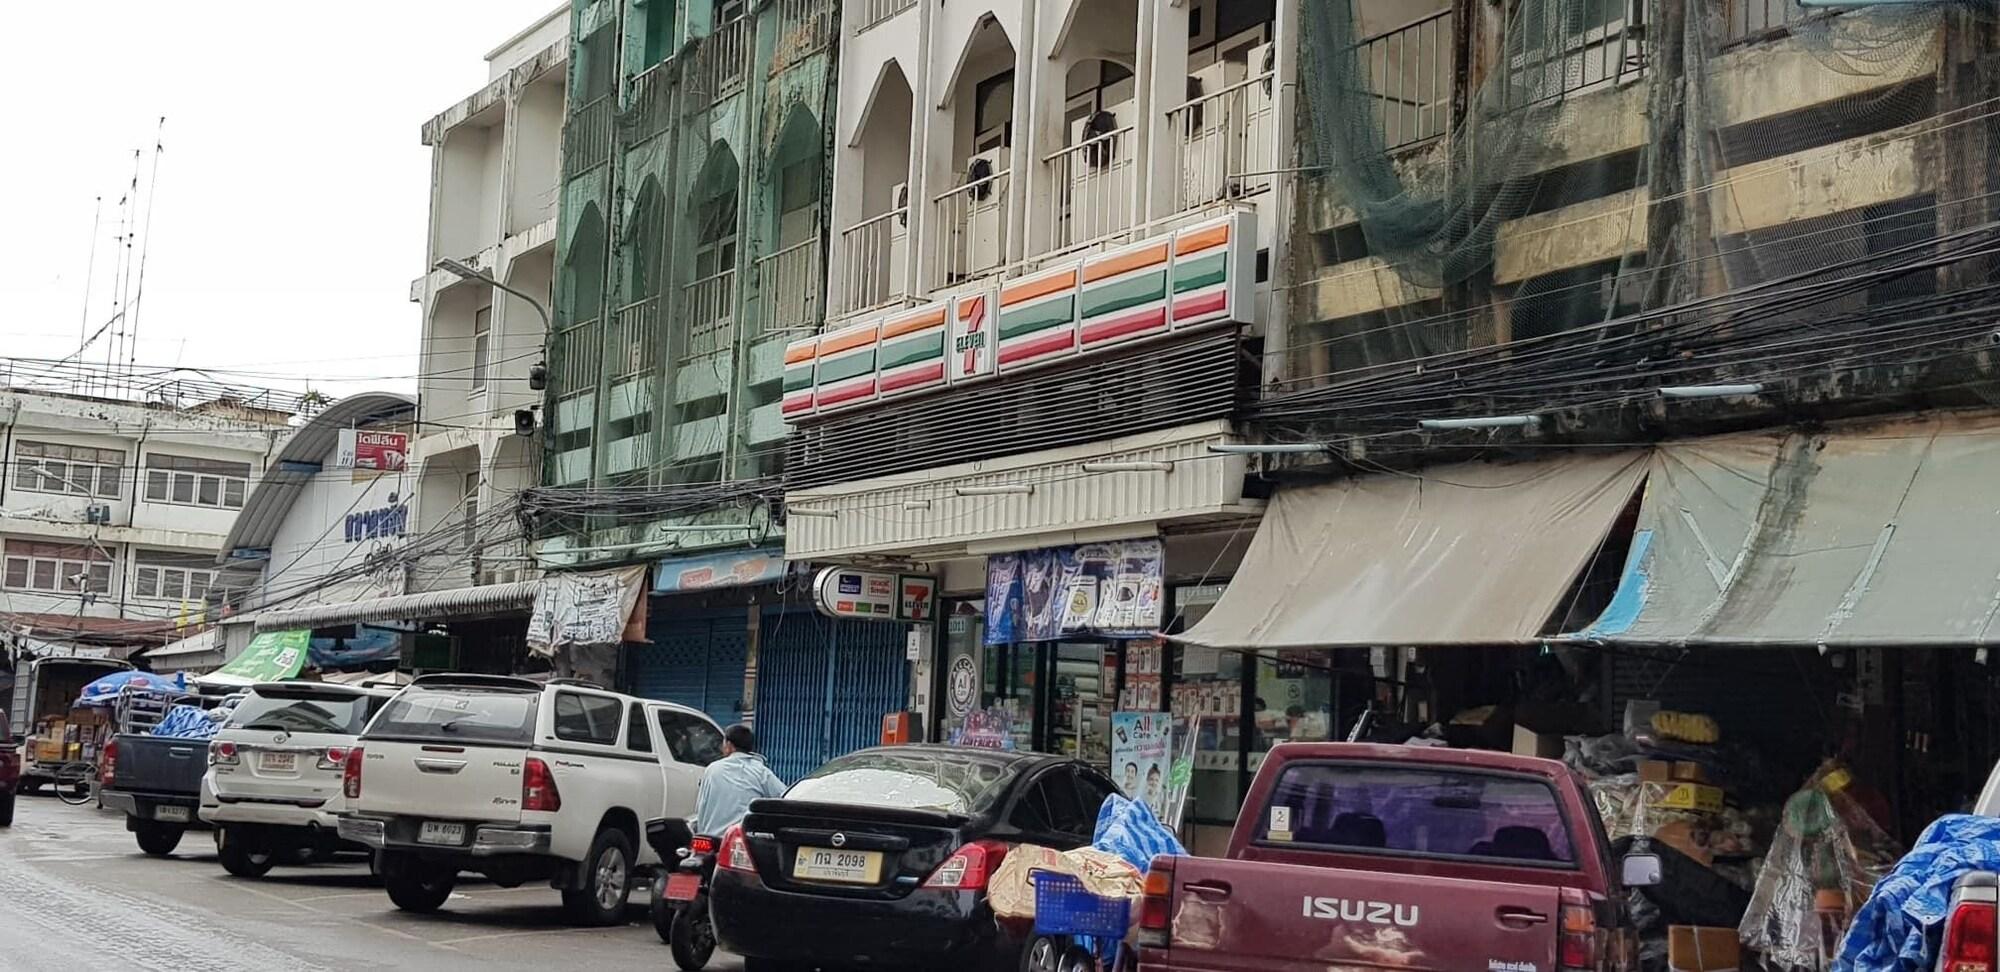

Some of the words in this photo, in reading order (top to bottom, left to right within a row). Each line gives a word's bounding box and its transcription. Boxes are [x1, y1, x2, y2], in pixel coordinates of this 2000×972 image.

[958, 294, 985, 375] 7
[905, 585, 929, 618] 7
[1133, 715, 1151, 731] All
[837, 853, 866, 868] 2098
[1302, 895, 1419, 927] ISUZU
